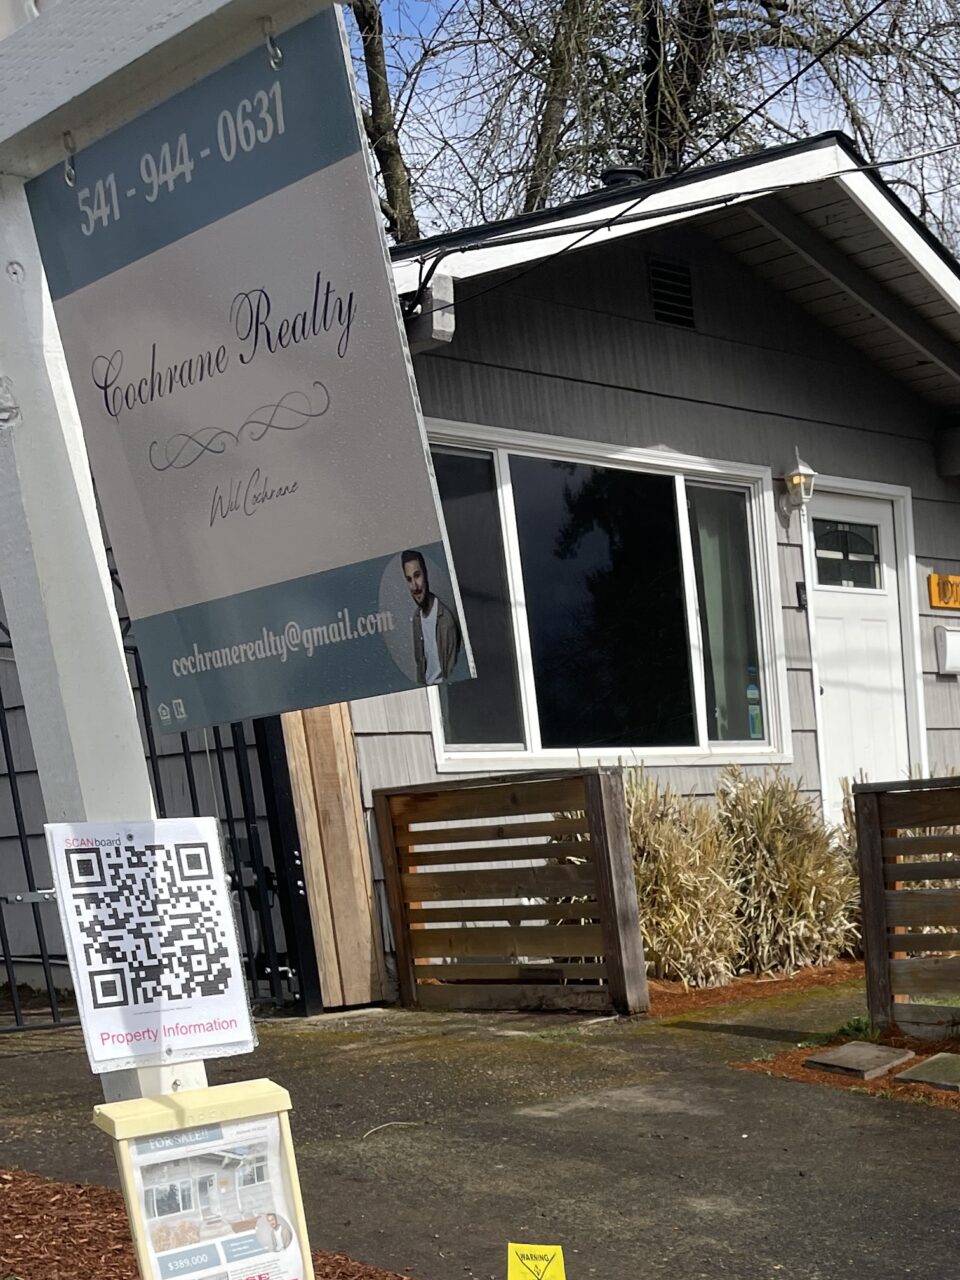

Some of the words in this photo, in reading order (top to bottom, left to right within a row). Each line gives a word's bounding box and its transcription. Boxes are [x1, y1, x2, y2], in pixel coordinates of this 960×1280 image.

[78, 172, 120, 236] 541
[140, 133, 194, 203] 944
[217, 80, 285, 162] 0631
[92, 343, 229, 424] Cochrane
[230, 271, 357, 364] Realty
[243, 467, 299, 517] Cochrane
[172, 607, 395, 677] cochranerealty@gmail.com
[64, 836, 122, 848] SCANboard
[100, 1027, 158, 1046] Property
[163, 1018, 238, 1037] Information
[150, 1136, 174, 1149] FOR
[520, 1253, 550, 1262] WARNING
